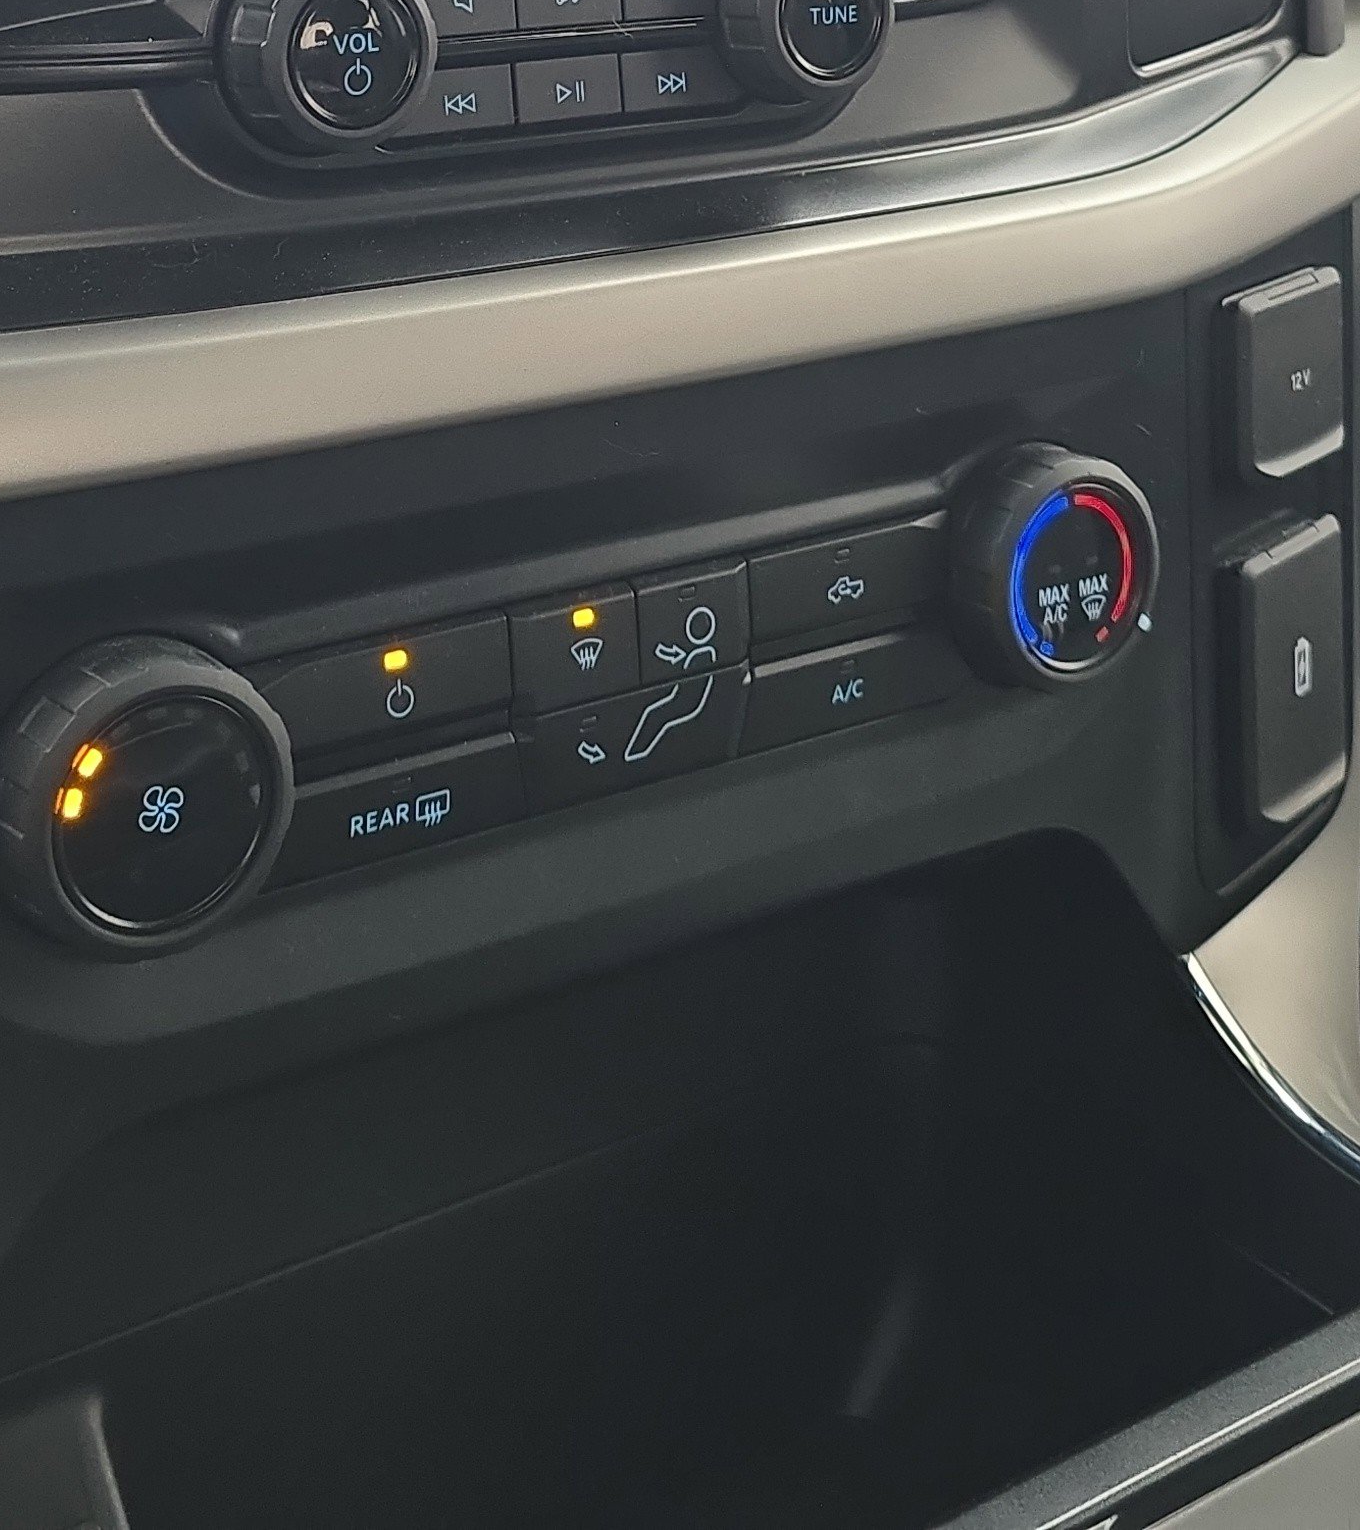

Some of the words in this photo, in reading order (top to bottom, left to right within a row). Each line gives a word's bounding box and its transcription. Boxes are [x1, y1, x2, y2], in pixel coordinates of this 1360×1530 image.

[809, 5, 858, 26] TUNE
[333, 33, 380, 56] VOL
[1291, 368, 1311, 392] 12V
[1039, 583, 1070, 607] MAX
[1079, 573, 1108, 597] MAX
[1043, 603, 1068, 625] A/C
[831, 678, 863, 704] A/C
[350, 802, 410, 838] REAR
